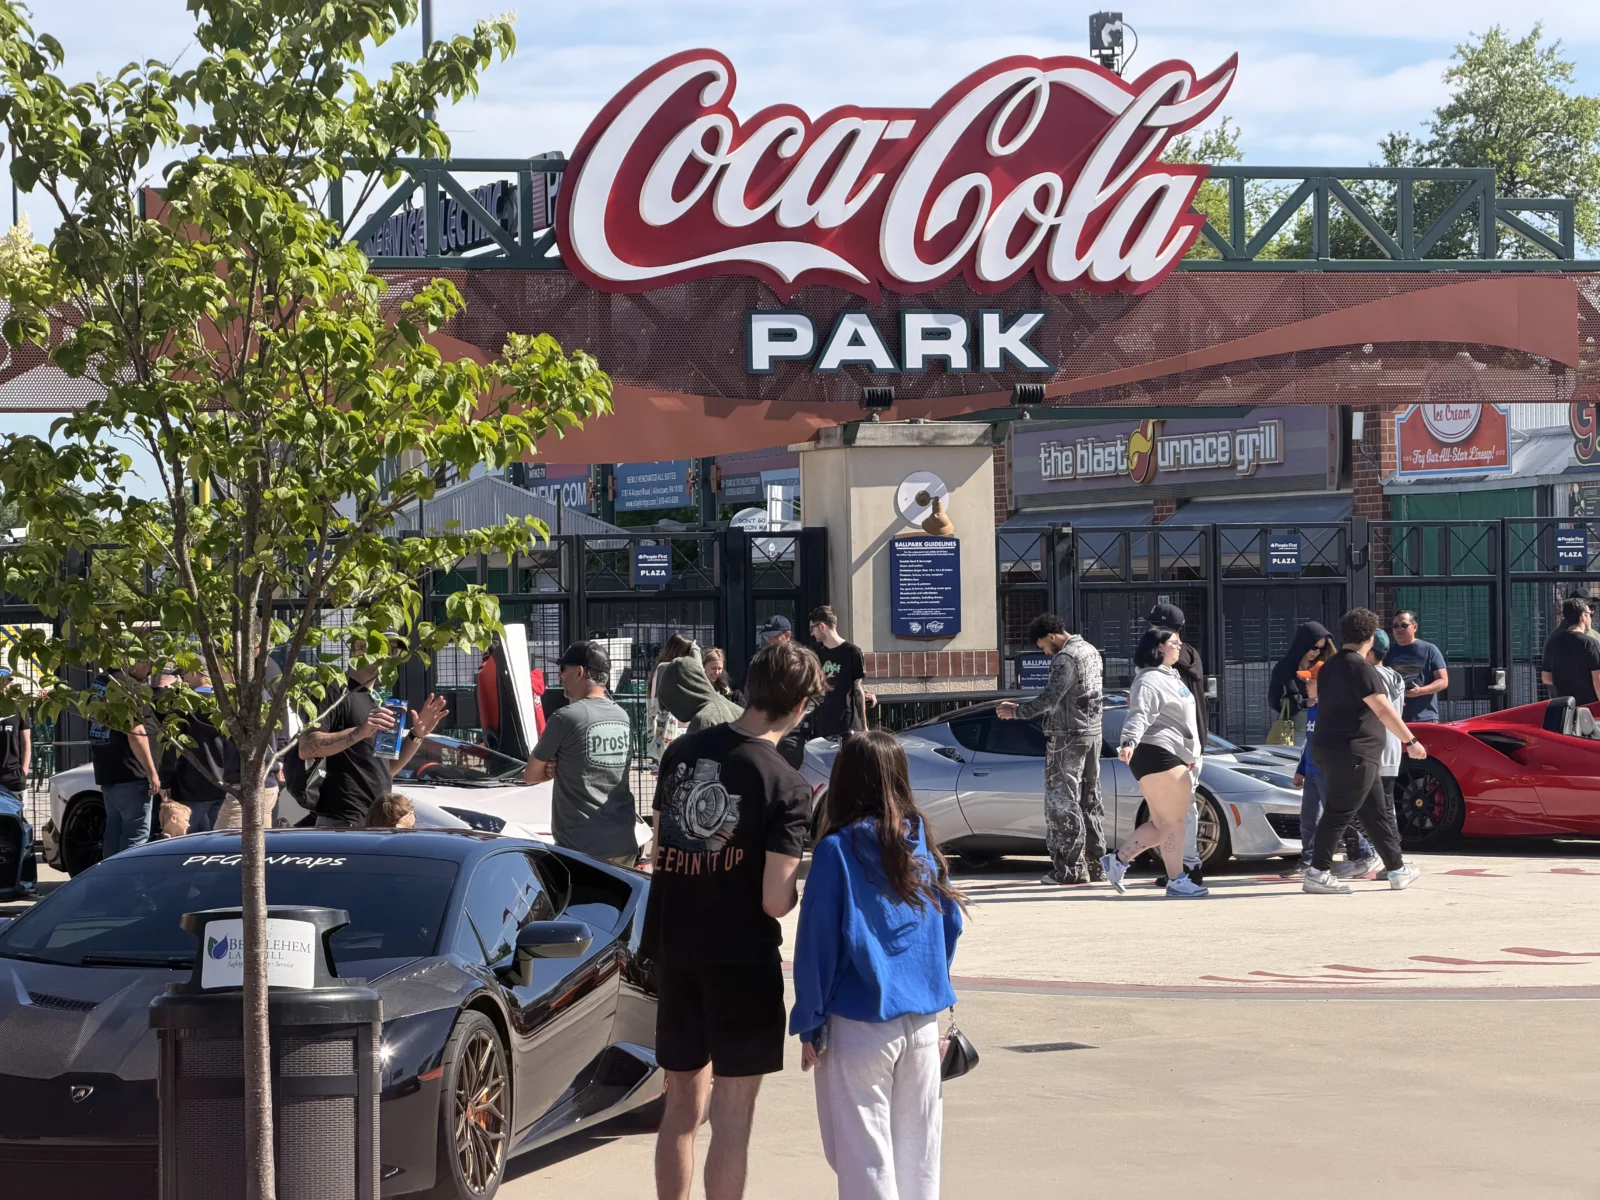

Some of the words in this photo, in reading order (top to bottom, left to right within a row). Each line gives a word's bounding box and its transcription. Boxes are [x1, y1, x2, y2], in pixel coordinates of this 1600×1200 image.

[569, 56, 1236, 284] Coca-Cola
[439, 180, 503, 252] LECTRIC
[748, 311, 1047, 372] PARK
[1433, 403, 1444, 422] Ice
[1445, 403, 1472, 422] Cream
[1039, 443, 1074, 478] the
[1076, 437, 1128, 475] blast
[1234, 423, 1279, 473] grill
[1412, 449, 1426, 468] Try
[1426, 448, 1439, 463] Our
[1439, 446, 1468, 463] All-Star
[1468, 444, 1496, 464] Lineup!
[1272, 557, 1297, 565] PLAZA
[640, 569, 666, 577] PLAZA
[1022, 659, 1052, 667] BALLPAR
[592, 730, 629, 753] Prost
[182, 854, 243, 866] PFG
[264, 854, 347, 869] Wraps
[706, 850, 720, 874] IT
[724, 846, 744, 872] UP
[228, 951, 285, 960] LAILL
[229, 938, 311, 954] BELEHEM
